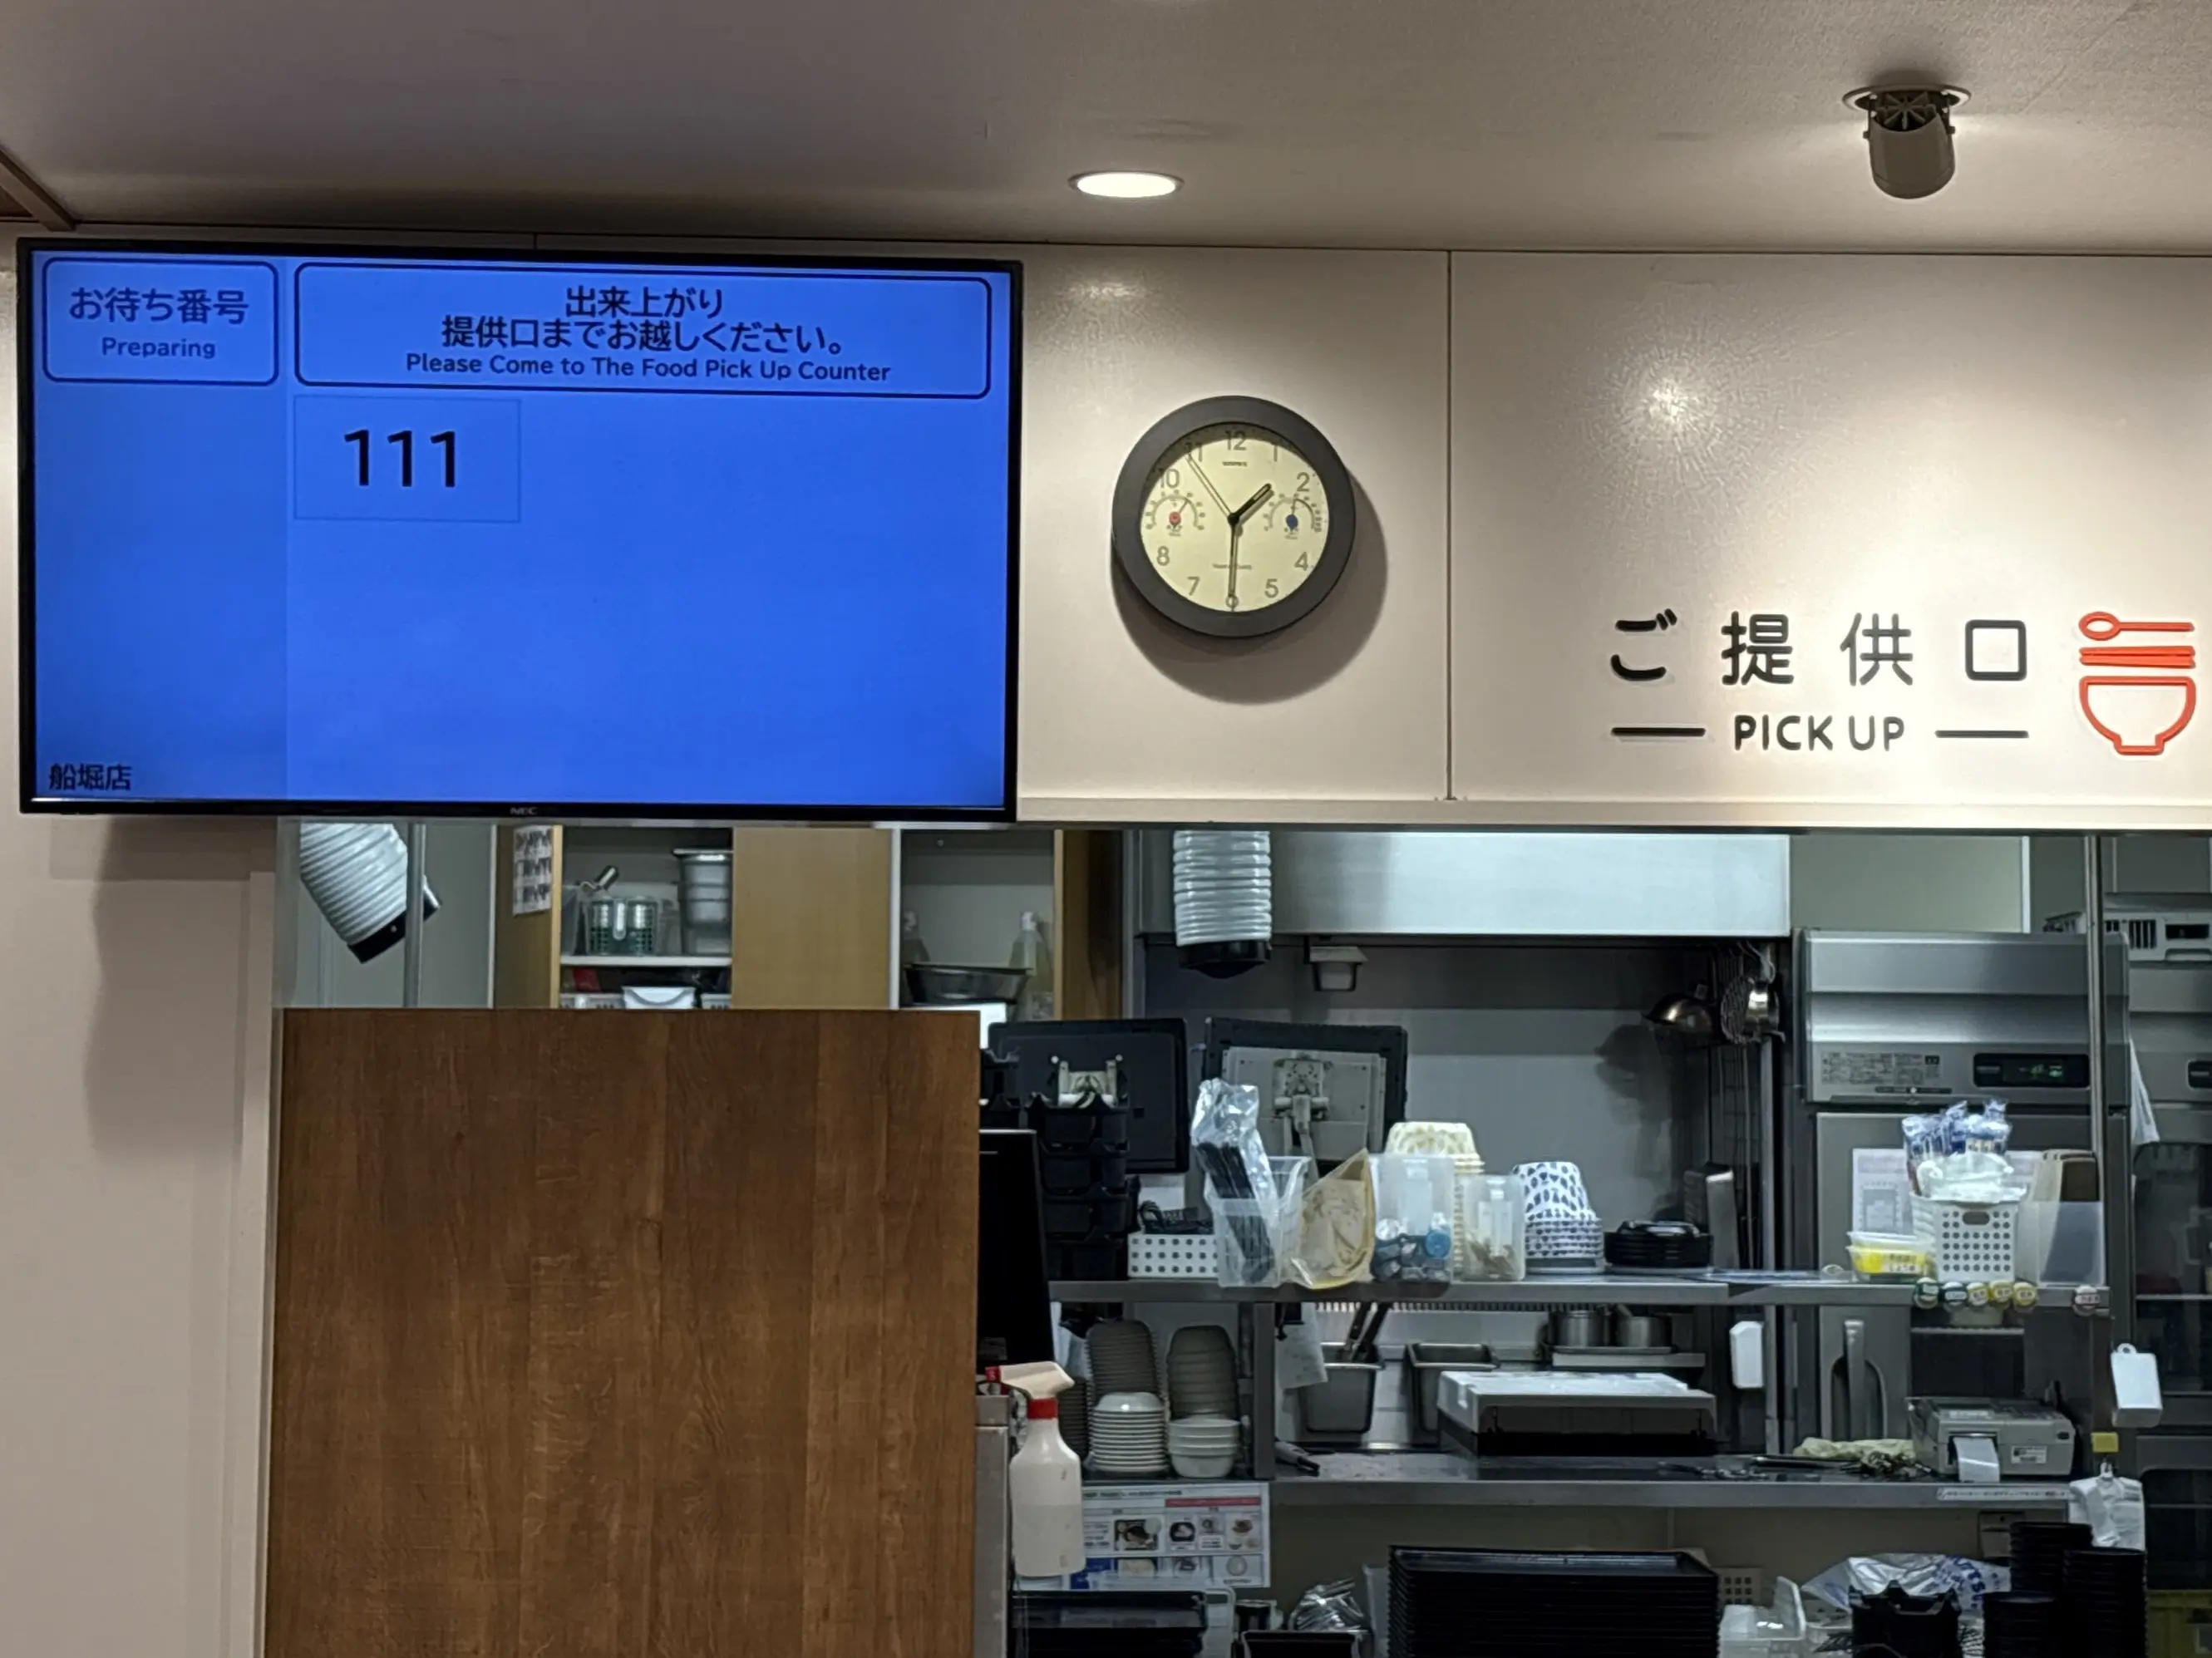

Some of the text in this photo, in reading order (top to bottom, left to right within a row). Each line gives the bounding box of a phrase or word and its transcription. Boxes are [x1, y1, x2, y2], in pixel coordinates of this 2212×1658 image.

[69, 287, 249, 324] お待ち番号
[565, 285, 722, 319] 出来上がり
[441, 314, 842, 355] 提供口までお越しください。
[101, 337, 216, 360] Preparing
[406, 352, 892, 381] Please Come to The Food Pick Up Counter
[1224, 430, 1247, 450] 12
[344, 429, 456, 487] 111
[1158, 468, 1180, 489] 10
[1296, 472, 1310, 492] 2
[1156, 545, 1170, 566] 8
[1293, 551, 1309, 571] 4
[1186, 576, 1200, 596] 7
[1264, 578, 1279, 598] 5
[1609, 608, 2027, 686] ご提供口
[1734, 715, 1905, 751] PICK UP
[48, 763, 132, 791] 船堀店
